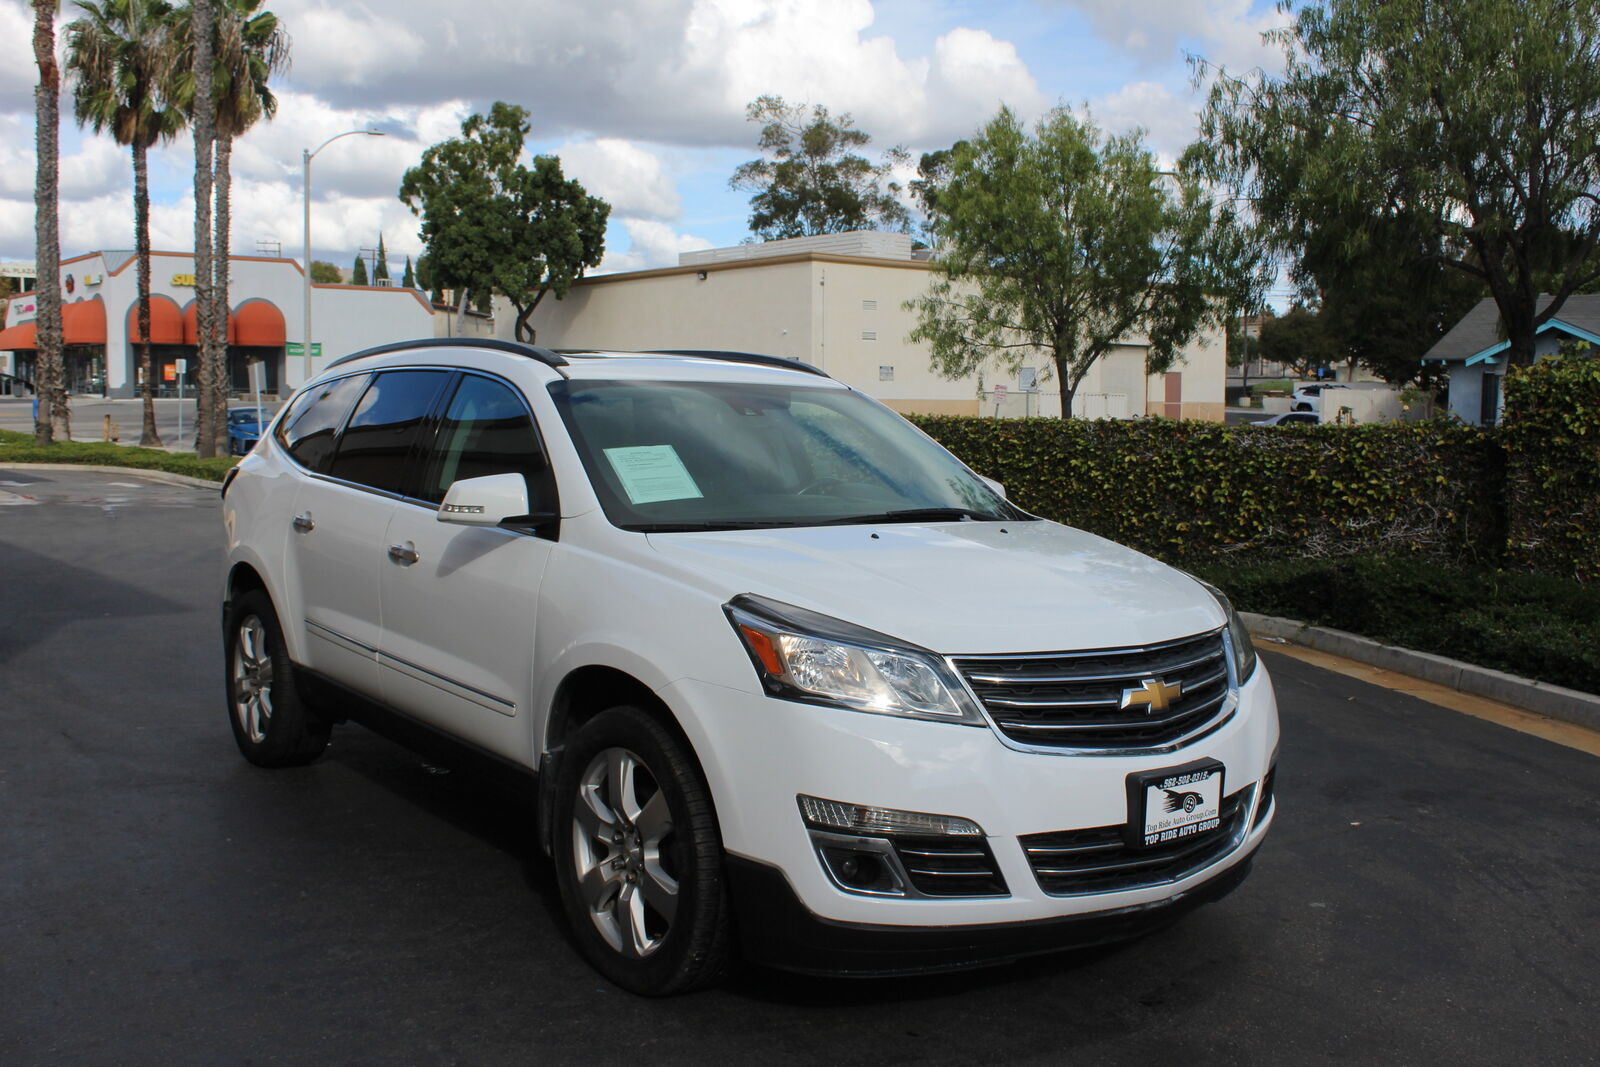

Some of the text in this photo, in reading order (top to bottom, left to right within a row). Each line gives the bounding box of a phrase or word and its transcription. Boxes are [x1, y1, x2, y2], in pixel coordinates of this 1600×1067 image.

[1145, 818, 1220, 845] TOP RIDE AUTO GROUP
[1147, 824, 1158, 832] Top
[1159, 820, 1171, 829] Ride
[1173, 817, 1185, 825] Auto
